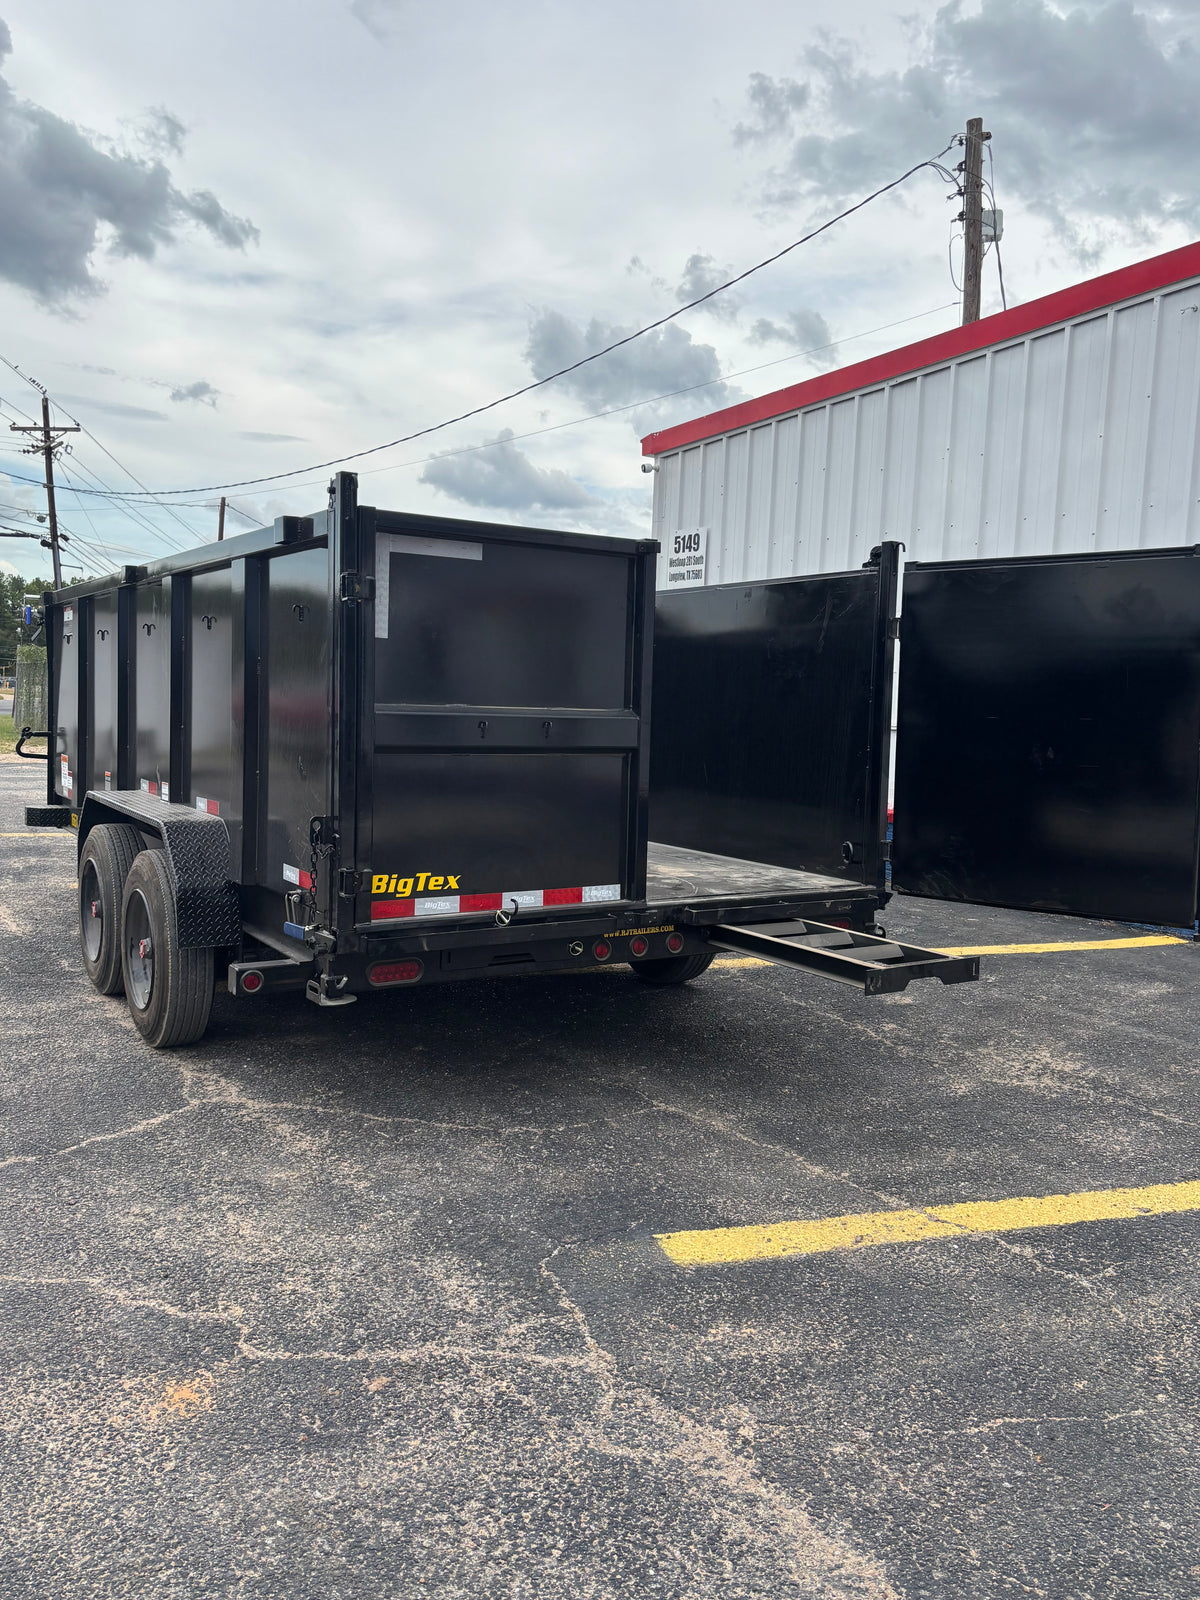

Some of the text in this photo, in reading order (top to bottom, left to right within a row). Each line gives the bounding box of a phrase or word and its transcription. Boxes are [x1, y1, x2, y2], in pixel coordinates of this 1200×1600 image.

[674, 533, 700, 553] 5149
[693, 555, 704, 565] South
[686, 570, 691, 580] TX
[371, 872, 462, 898] BigTex
[424, 901, 451, 910] BigTex
